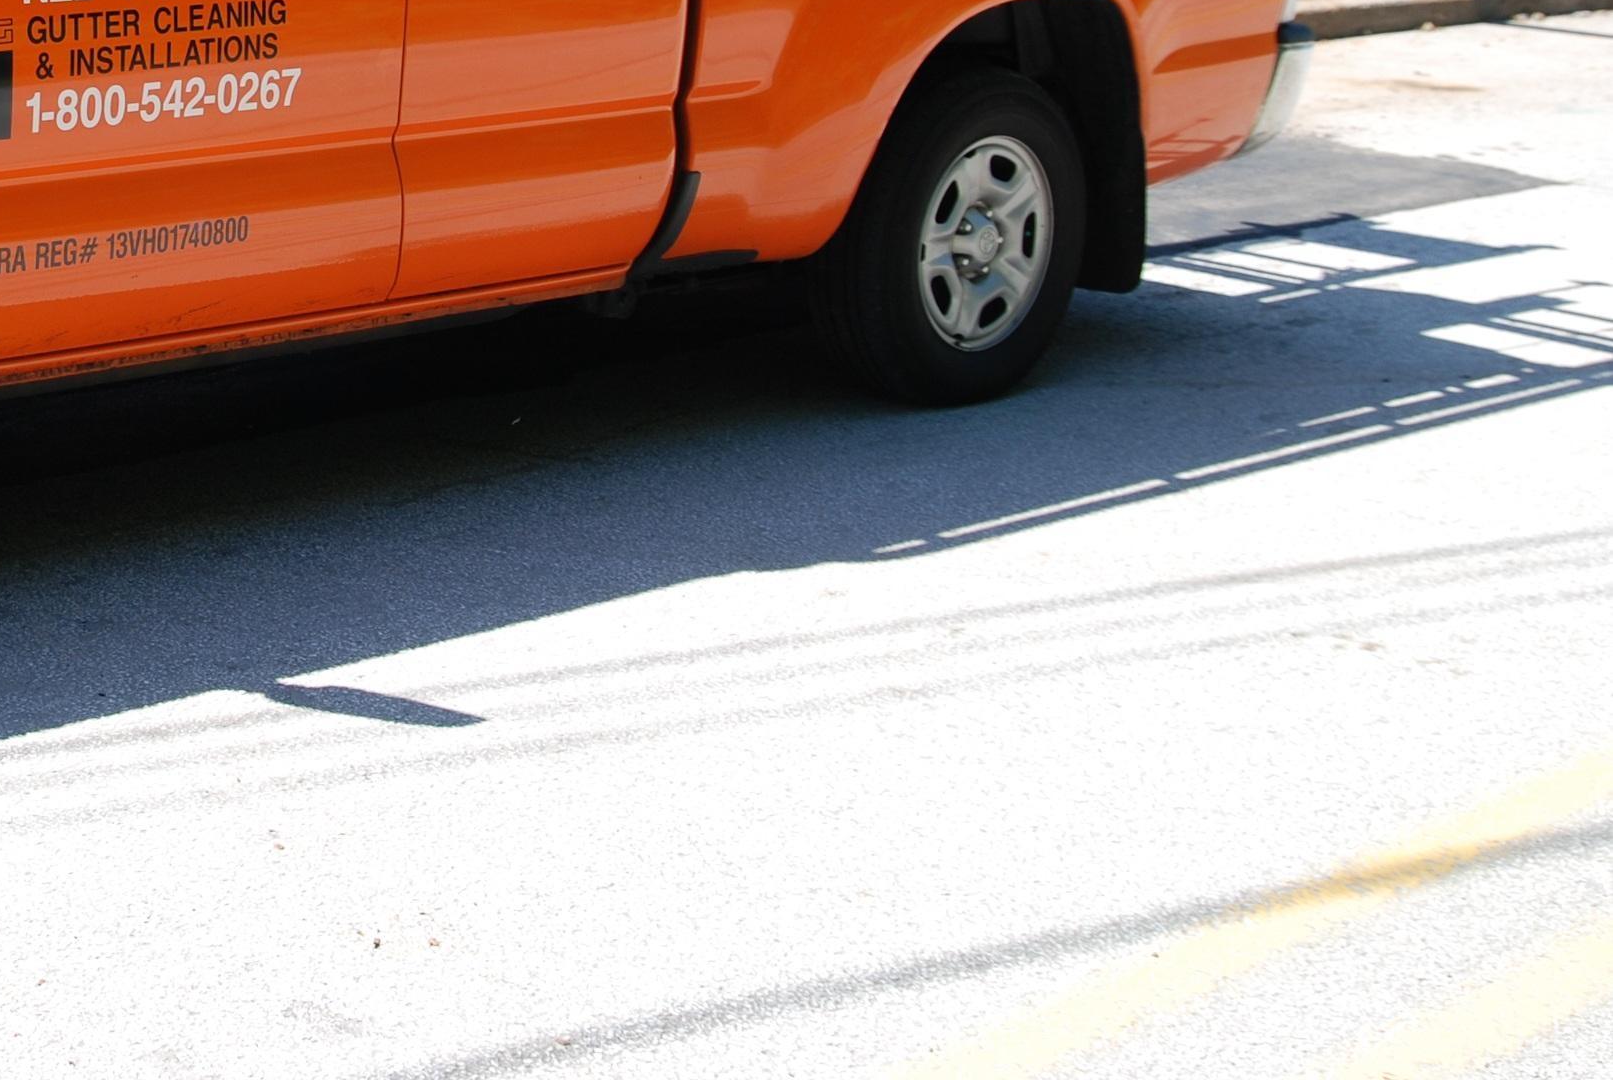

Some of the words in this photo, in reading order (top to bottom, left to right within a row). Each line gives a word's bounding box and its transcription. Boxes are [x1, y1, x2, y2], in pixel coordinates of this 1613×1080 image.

[26, 8, 141, 45] GUTTER
[35, 51, 55, 80] &
[68, 31, 279, 76] INSTALLATIONS
[24, 66, 302, 134] 1-800-542-0267
[34, 236, 99, 270] REG#
[106, 215, 249, 260] 13VH01740800
